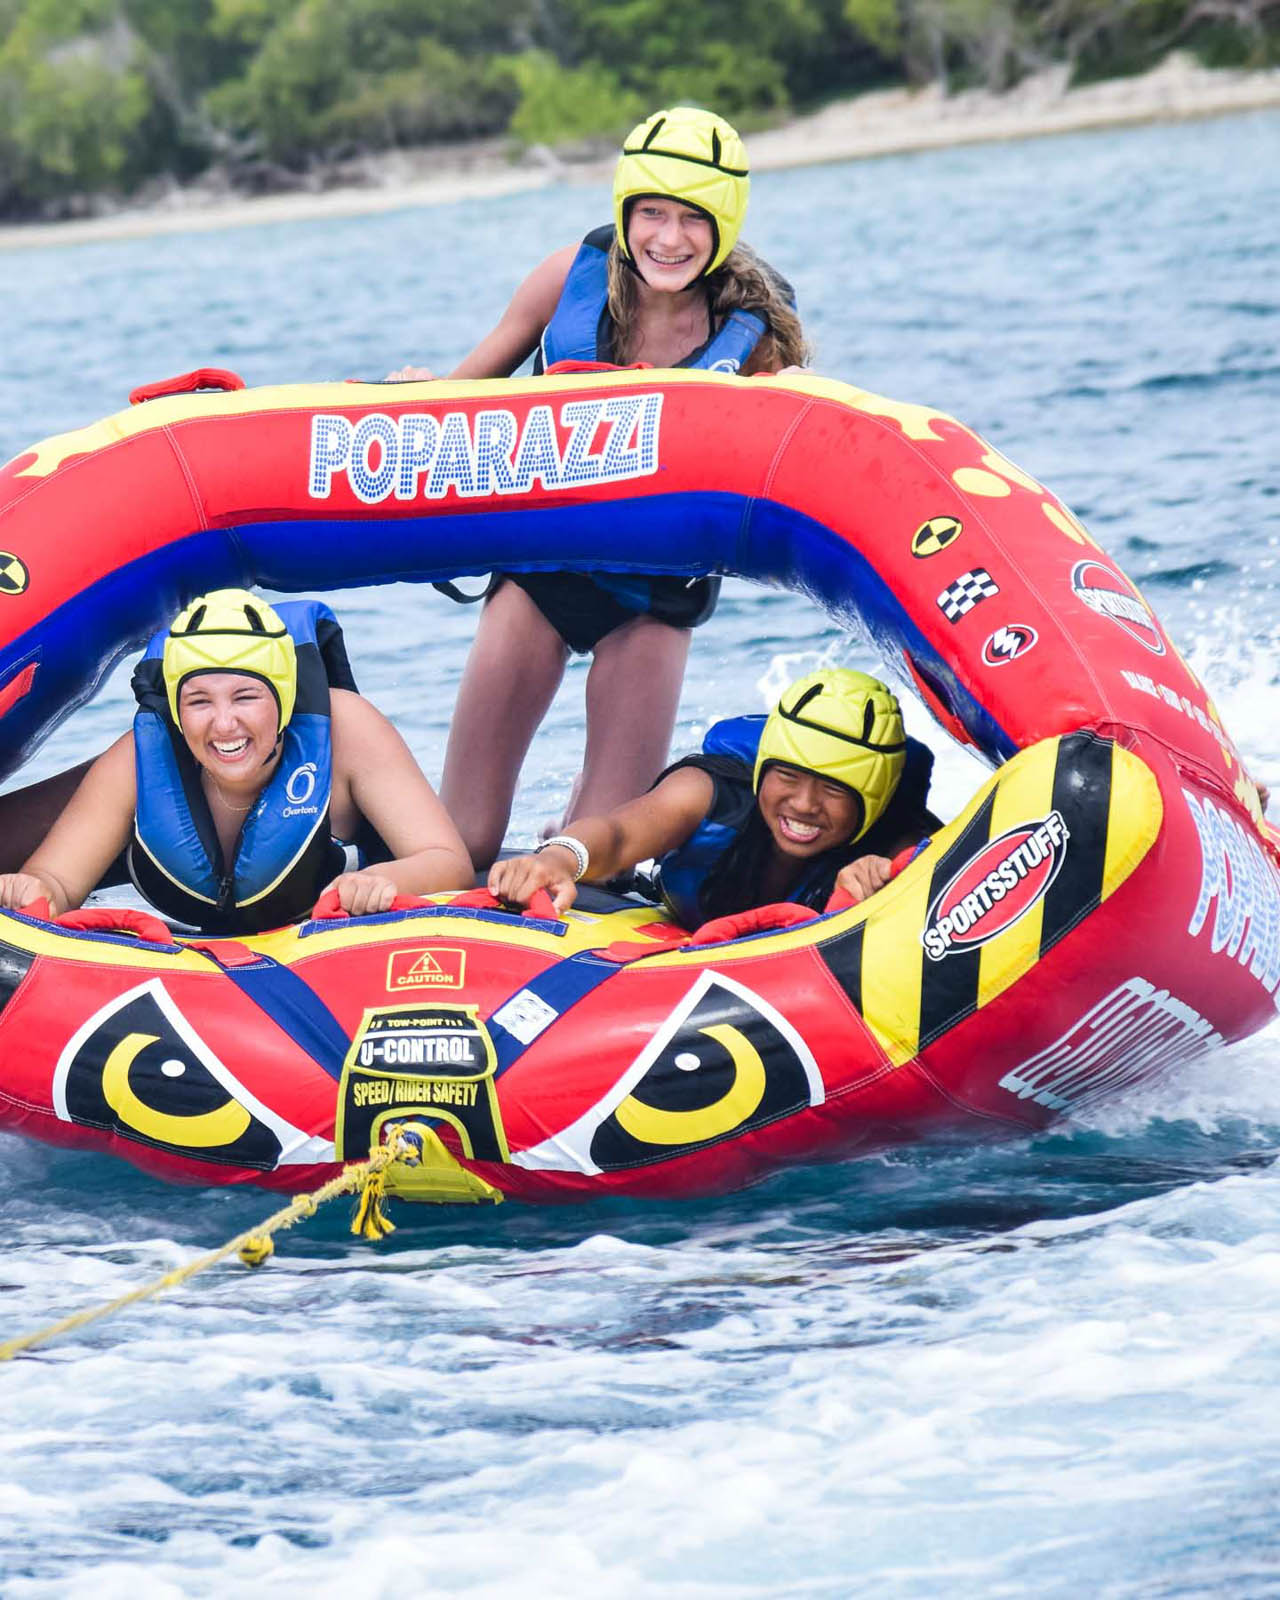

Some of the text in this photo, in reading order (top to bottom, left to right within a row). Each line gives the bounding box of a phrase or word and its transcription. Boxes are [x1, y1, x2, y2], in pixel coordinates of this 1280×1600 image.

[309, 392, 664, 504] POPARAZZI
[923, 811, 1066, 960] SPORTSSTUFF
[397, 973, 454, 985] CAUTION
[387, 1017, 443, 1028] TOW-POINT
[360, 1036, 475, 1067] U-CONTROL
[432, 1081, 478, 1106] SAFETY
